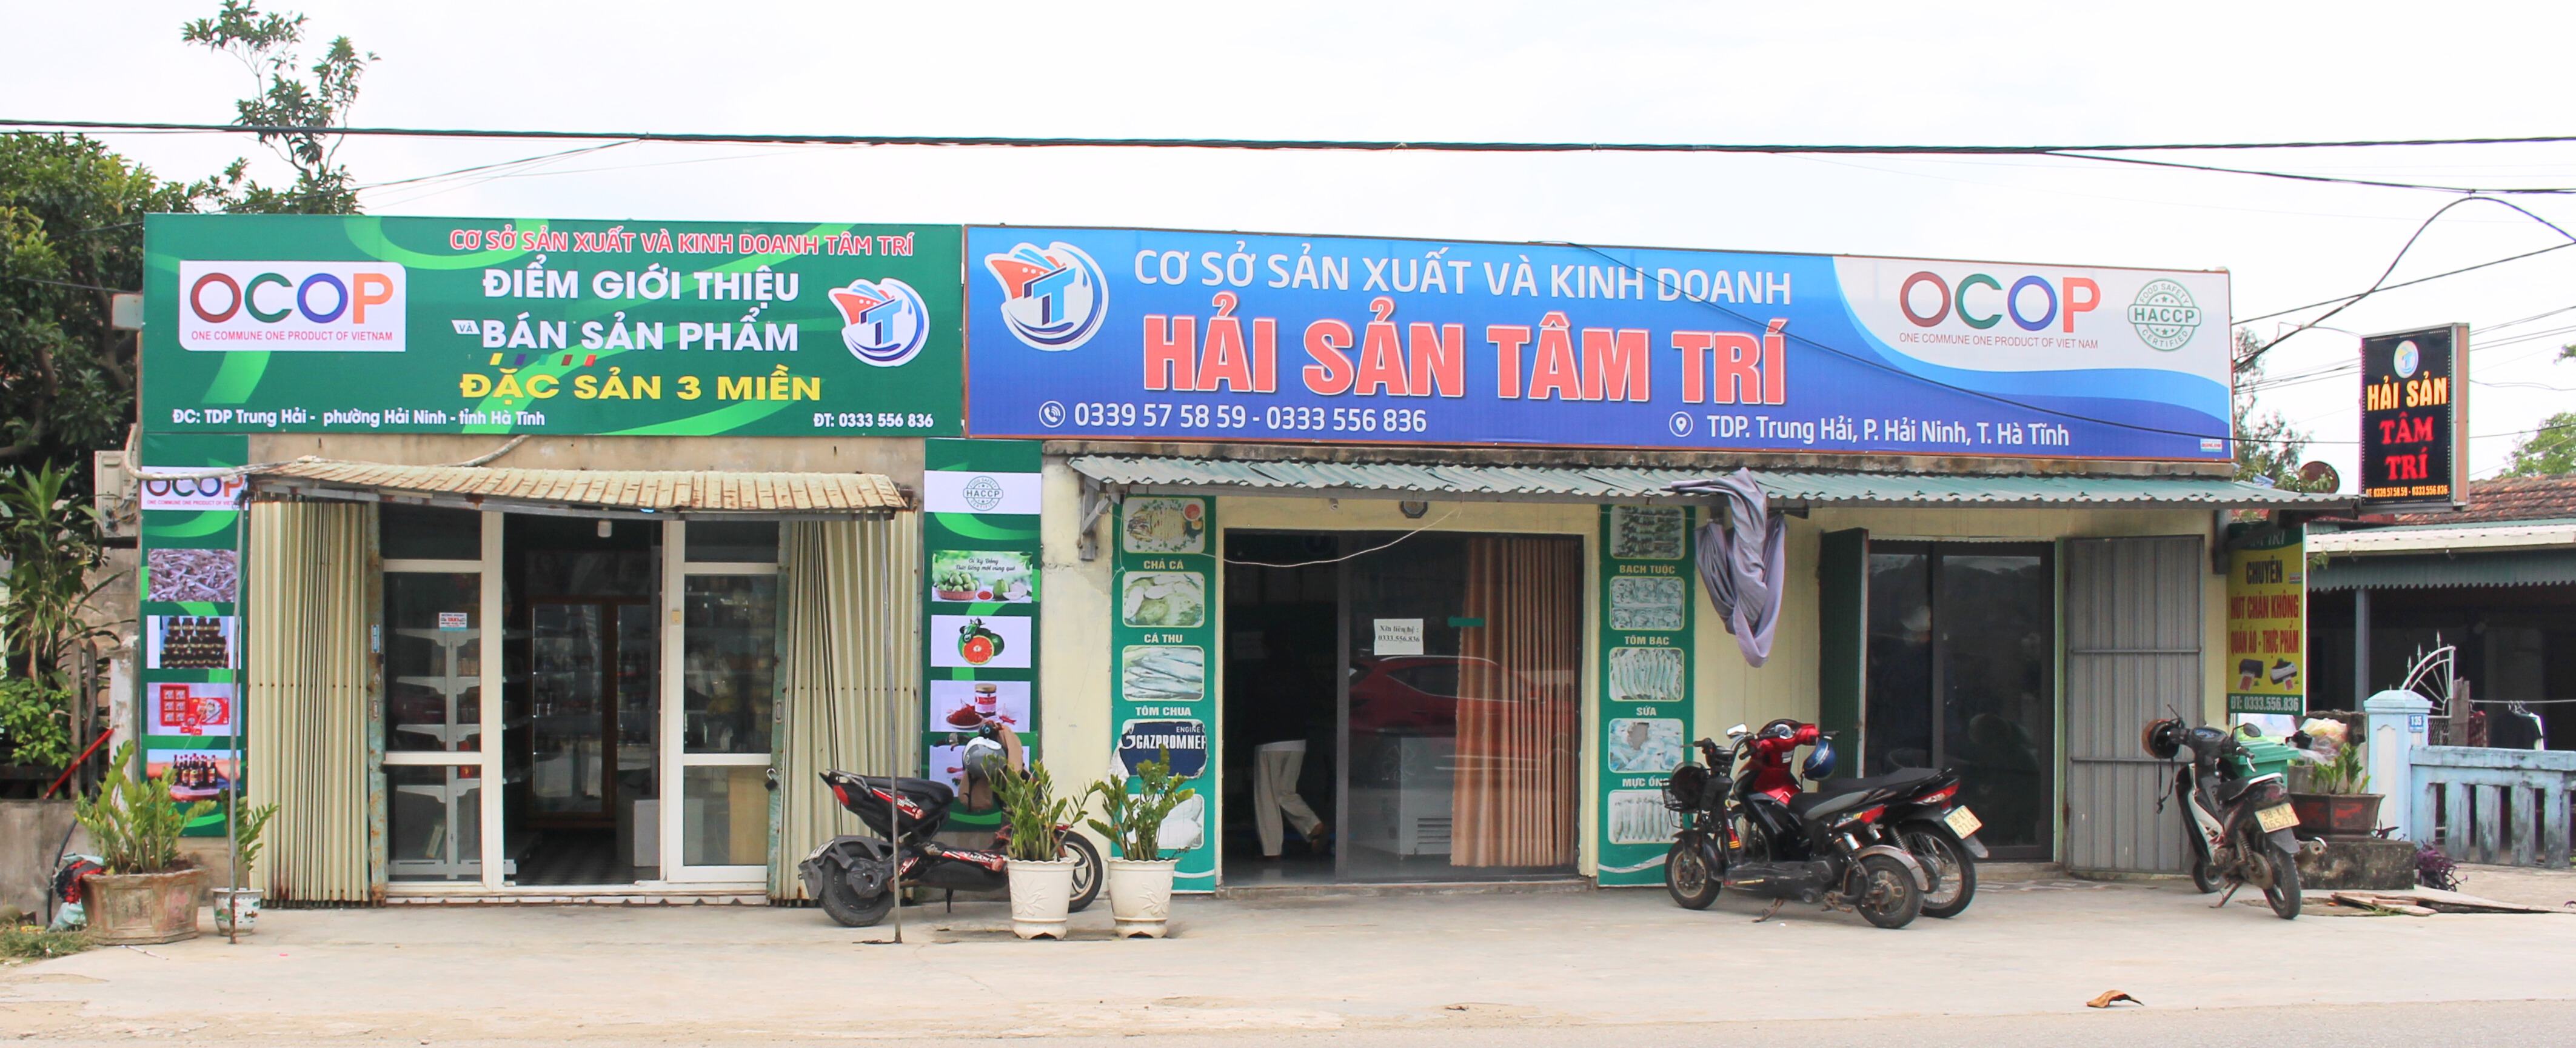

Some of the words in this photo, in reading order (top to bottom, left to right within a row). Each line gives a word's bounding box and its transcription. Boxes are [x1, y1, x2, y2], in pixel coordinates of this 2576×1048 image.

[450, 229, 482, 251] CƠ
[486, 224, 517, 251] SỞ
[522, 225, 569, 252] SẢN
[573, 226, 636, 253] XUẤT
[641, 229, 672, 254] VÀ
[678, 233, 734, 255] KINH
[740, 233, 819, 255] DOANH
[826, 231, 877, 256] TÂM
[882, 232, 915, 256] TRÍ
[483, 255, 579, 299] ĐIỂM
[592, 264, 681, 301] GIỚI
[694, 264, 799, 309] THIỆU
[1134, 249, 1190, 284] CƠ
[1202, 241, 1257, 287] SỞ
[1267, 244, 1348, 291] SẢN
[1362, 247, 1471, 295] XUẤT
[1484, 255, 1538, 297] VÀ
[1551, 264, 1644, 300] KINH
[1658, 267, 1791, 305] DOANH
[190, 272, 395, 324] OCOP
[1899, 270, 2101, 333] OCOP
[2139, 285, 2158, 303] FOOD
[2161, 282, 2190, 304] SAFETY
[2134, 307, 2195, 323] HACCP
[191, 331, 212, 341] ONE
[214, 331, 263, 341] COMMUNE
[265, 331, 286, 341] ONE
[287, 332, 333, 341] PRODUCT
[335, 332, 349, 341] OF
[350, 332, 393, 341] VIETNAM
[457, 323, 473, 333] VÀ
[483, 312, 566, 350] BÁN
[581, 312, 664, 351] SẢN
[678, 307, 799, 352] PHẨM
[1899, 333, 1919, 344] ONE
[1922, 334, 1970, 345] COMMUNE
[1973, 335, 1992, 346] ONE
[1995, 336, 2039, 348] PRODUCT
[2041, 338, 2053, 348] OF
[2056, 338, 2076, 349] VIET
[2078, 339, 2098, 349] NAM
[2142, 329, 2188, 348] CERTIFIED
[1143, 290, 1277, 393] HẢI
[1302, 296, 1464, 398] SẢN
[1487, 311, 1650, 403] TÂM
[1671, 318, 1789, 406] TRÍ
[460, 367, 559, 406] ĐẶC
[574, 367, 661, 401] SẢN
[677, 375, 701, 401] 3
[717, 364, 821, 401] MIỀN
[2367, 375, 2400, 411] HẢI
[2406, 370, 2447, 408] SẢN
[173, 409, 201, 424] ĐC:
[204, 409, 233, 424] TDP
[236, 409, 277, 428] Trung
[281, 407, 307, 424] Hải
[323, 407, 380, 428] phường
[384, 407, 409, 424] Hải
[414, 410, 447, 425] Ninh
[459, 408, 486, 426] tỉnh
[491, 409, 511, 426] Hà
[814, 413, 835, 427] ĐT:
[838, 413, 874, 427] 0333
[877, 413, 904, 427] 556
[908, 413, 934, 428] 836
[1074, 402, 1135, 427] 0339
[1143, 404, 1172, 429] 57
[1180, 404, 1210, 429] 58
[1217, 404, 1246, 429] 59
[1266, 406, 1325, 431] 0333
[1333, 407, 1377, 432] 556
[1383, 407, 1427, 432] 836
[2378, 411, 2434, 445] TÂM
[1707, 415, 1750, 438] TDP.
[1756, 416, 1815, 445] Trung
[1821, 415, 1858, 445] Hải,
[1864, 418, 1879, 441] P.
[1884, 417, 1916, 443] Hải
[1922, 419, 1972, 447] Ninh,
[1976, 422, 1993, 445] T.
[1998, 422, 2024, 446] Hà
[2028, 423, 2069, 447] Tĩnh
[2385, 446, 2429, 481] TRÍ
[146, 472, 244, 498] OCOP
[1169, 559, 1184, 570] CÁ
[1619, 565, 1647, 576] BẠCH
[2246, 555, 2283, 585] CHUYÊN
[2231, 590, 2246, 619] HÚT
[2247, 590, 2269, 619] CHÂN
[2271, 589, 2299, 618] KHÔNG
[1144, 632, 1159, 643] CÁ
[1162, 633, 1183, 644] THU
[1625, 634, 1646, 645] TÔM
[1649, 636, 1670, 647] BẠC
[1136, 705, 1159, 716] TÔM
[1162, 707, 1191, 716] CHUA
[2231, 696, 2242, 710] ĐT:
[2244, 696, 2299, 712] 0333.556.836
[1622, 777, 1645, 789] MỰC
